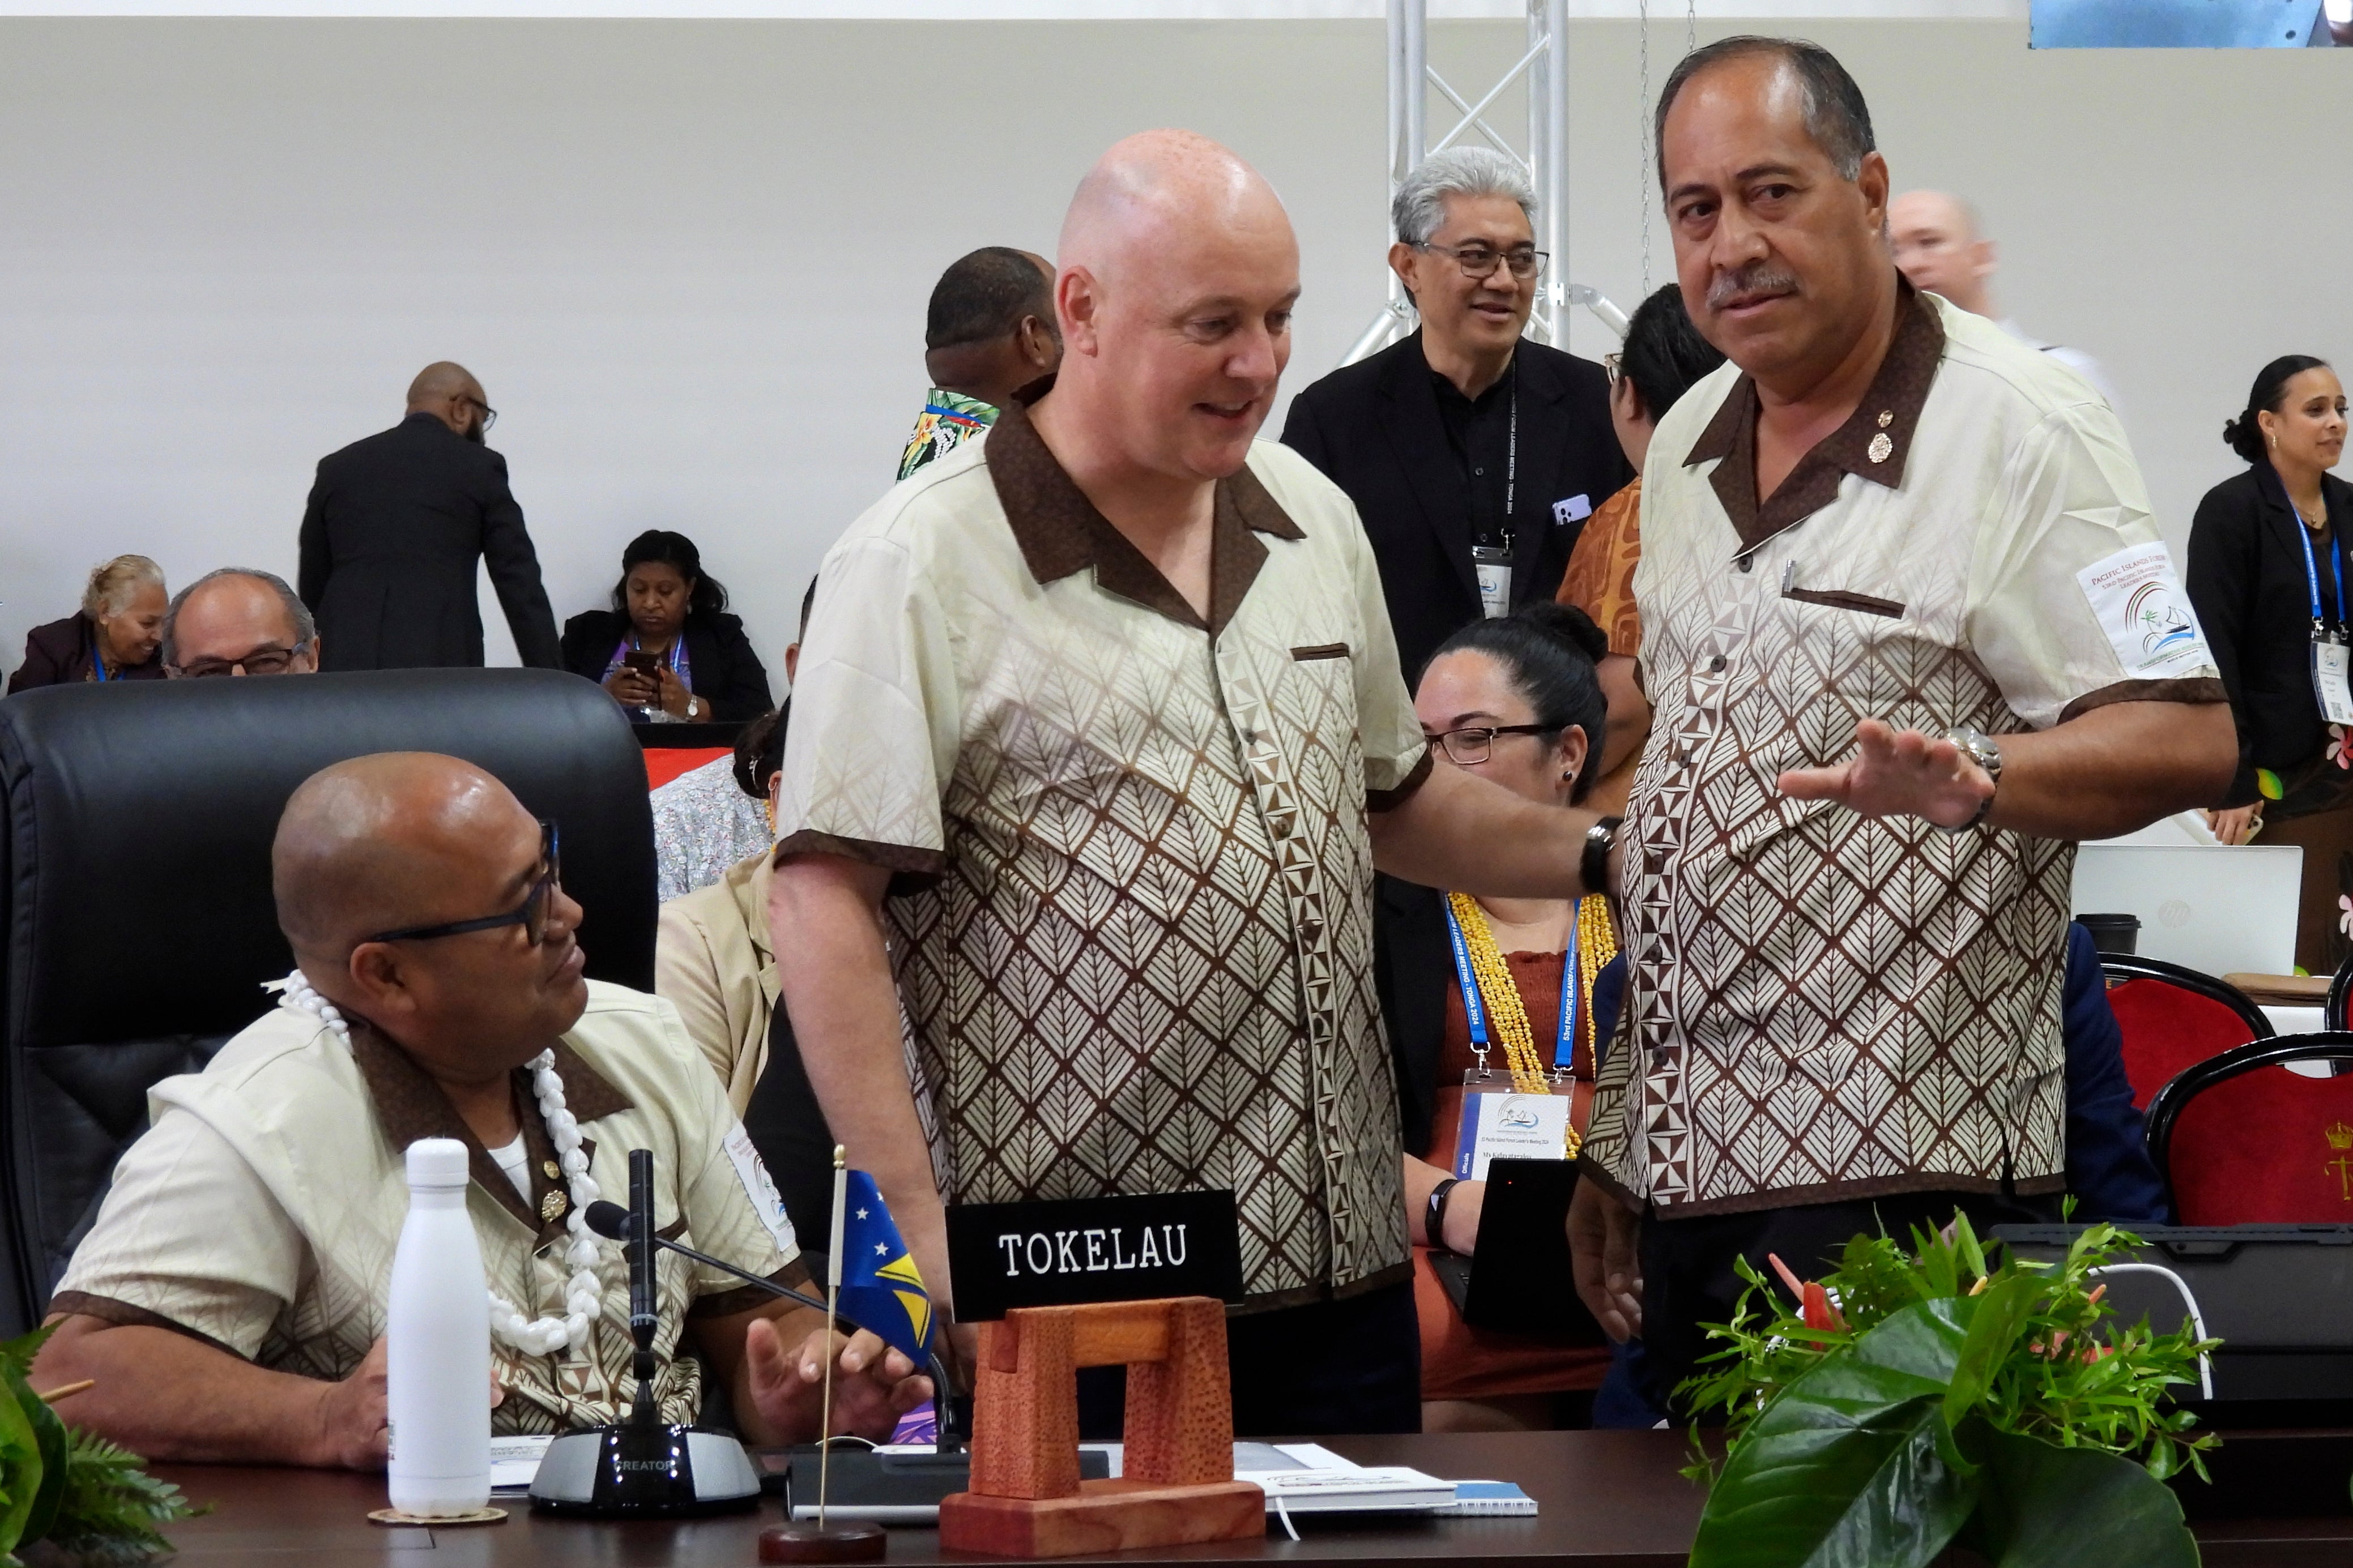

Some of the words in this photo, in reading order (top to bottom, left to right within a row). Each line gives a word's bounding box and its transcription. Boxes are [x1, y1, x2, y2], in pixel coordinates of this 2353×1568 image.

[2091, 568, 2121, 586] PACIFIC
[1453, 929, 1464, 955] LEADERS
[1459, 956, 1470, 982] MEETING
[1466, 986, 1476, 1008] TONGA
[1470, 1009, 1480, 1025] 2024
[999, 1224, 1186, 1276] TOKELAU
[613, 1460, 675, 1472] CREATOR
